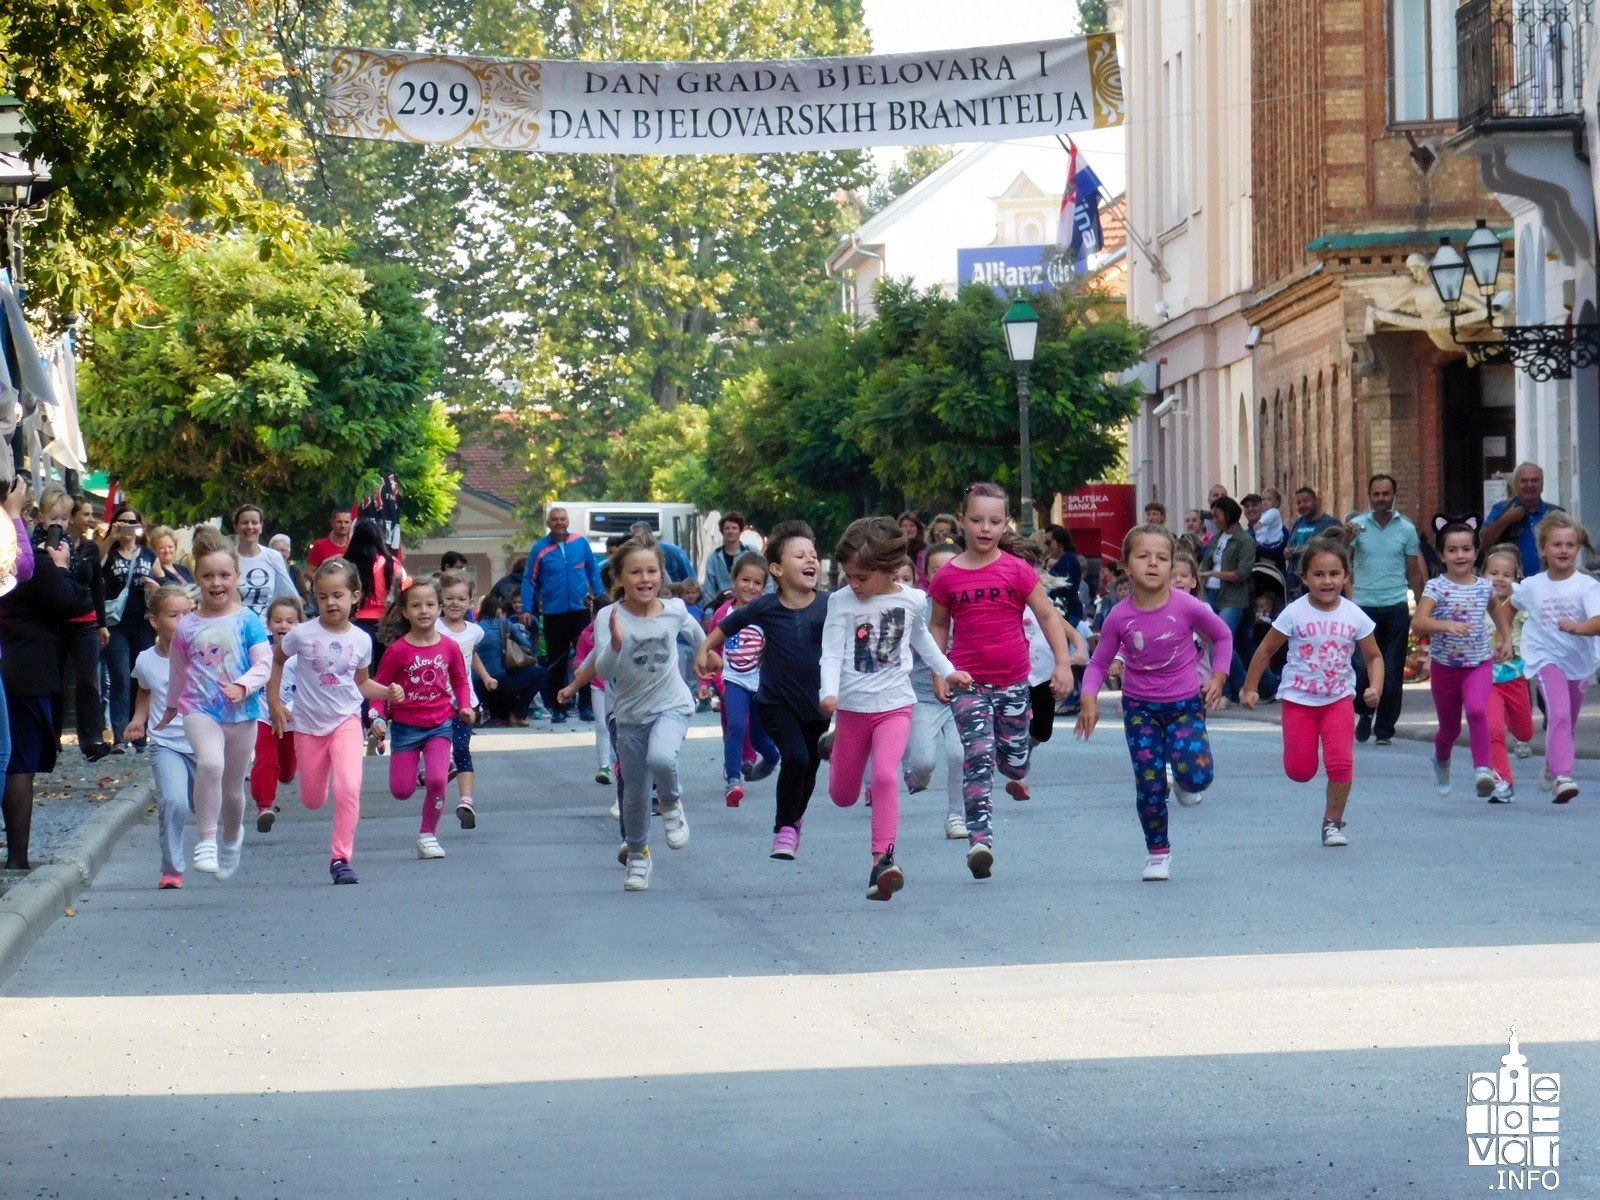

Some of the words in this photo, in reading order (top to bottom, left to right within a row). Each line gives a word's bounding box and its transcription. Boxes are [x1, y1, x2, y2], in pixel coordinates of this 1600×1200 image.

[584, 71, 661, 96] DAN
[676, 68, 802, 95] GRADA
[817, 54, 1016, 92] BJELOVARA
[1038, 50, 1050, 78] I
[397, 80, 475, 116] 29.9.
[548, 107, 622, 140] DAN
[633, 101, 876, 145] BJELOVARSKIH
[888, 90, 1089, 132] BRANITELJA
[971, 261, 1043, 287] Allianz
[1068, 495, 1109, 503] SPLITSKA
[1068, 503, 1097, 511] BANKA
[947, 587, 1015, 604] HAPPY
[1296, 620, 1357, 640] LOVELY
